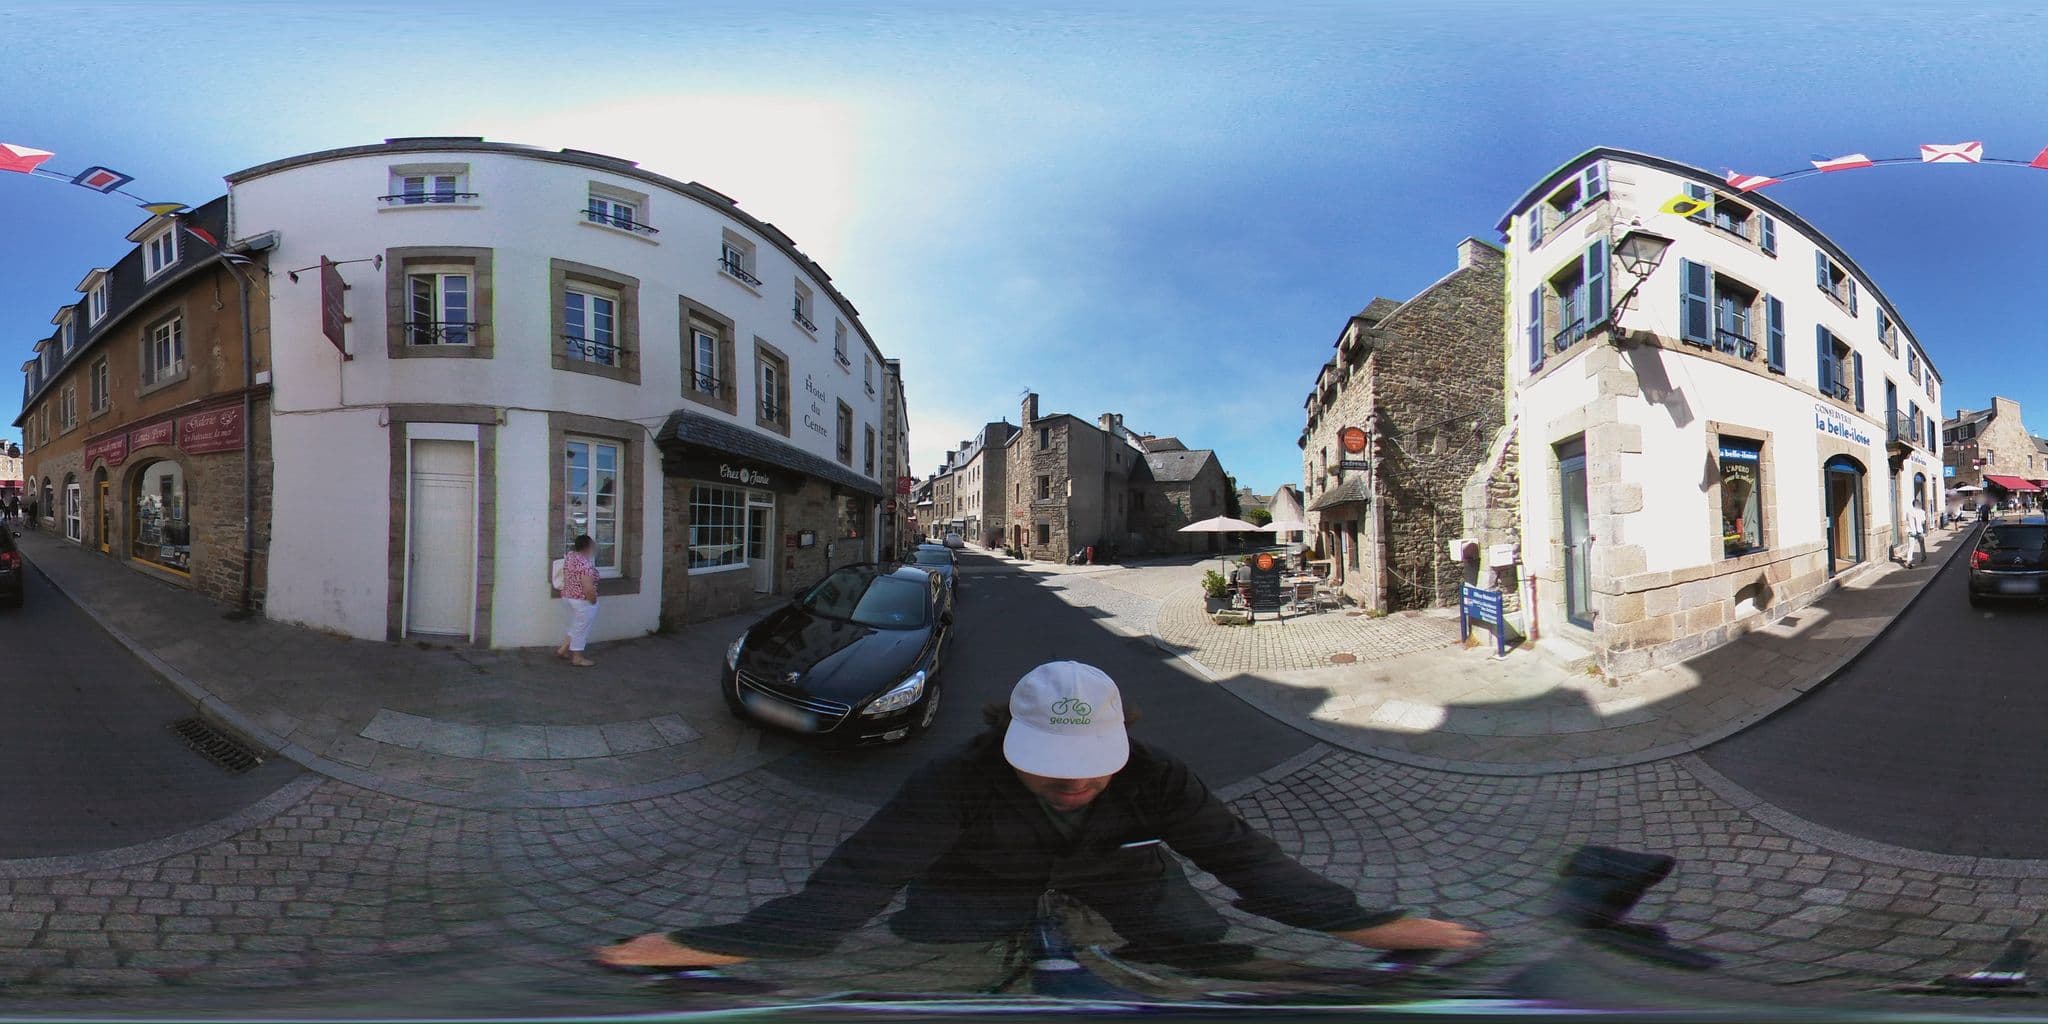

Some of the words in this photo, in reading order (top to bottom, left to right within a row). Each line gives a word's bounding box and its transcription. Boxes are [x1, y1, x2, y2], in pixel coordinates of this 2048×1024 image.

[811, 401, 821, 416] du
[804, 414, 828, 438] Centre
[1815, 413, 1825, 430] la
[720, 463, 739, 479] Chez
